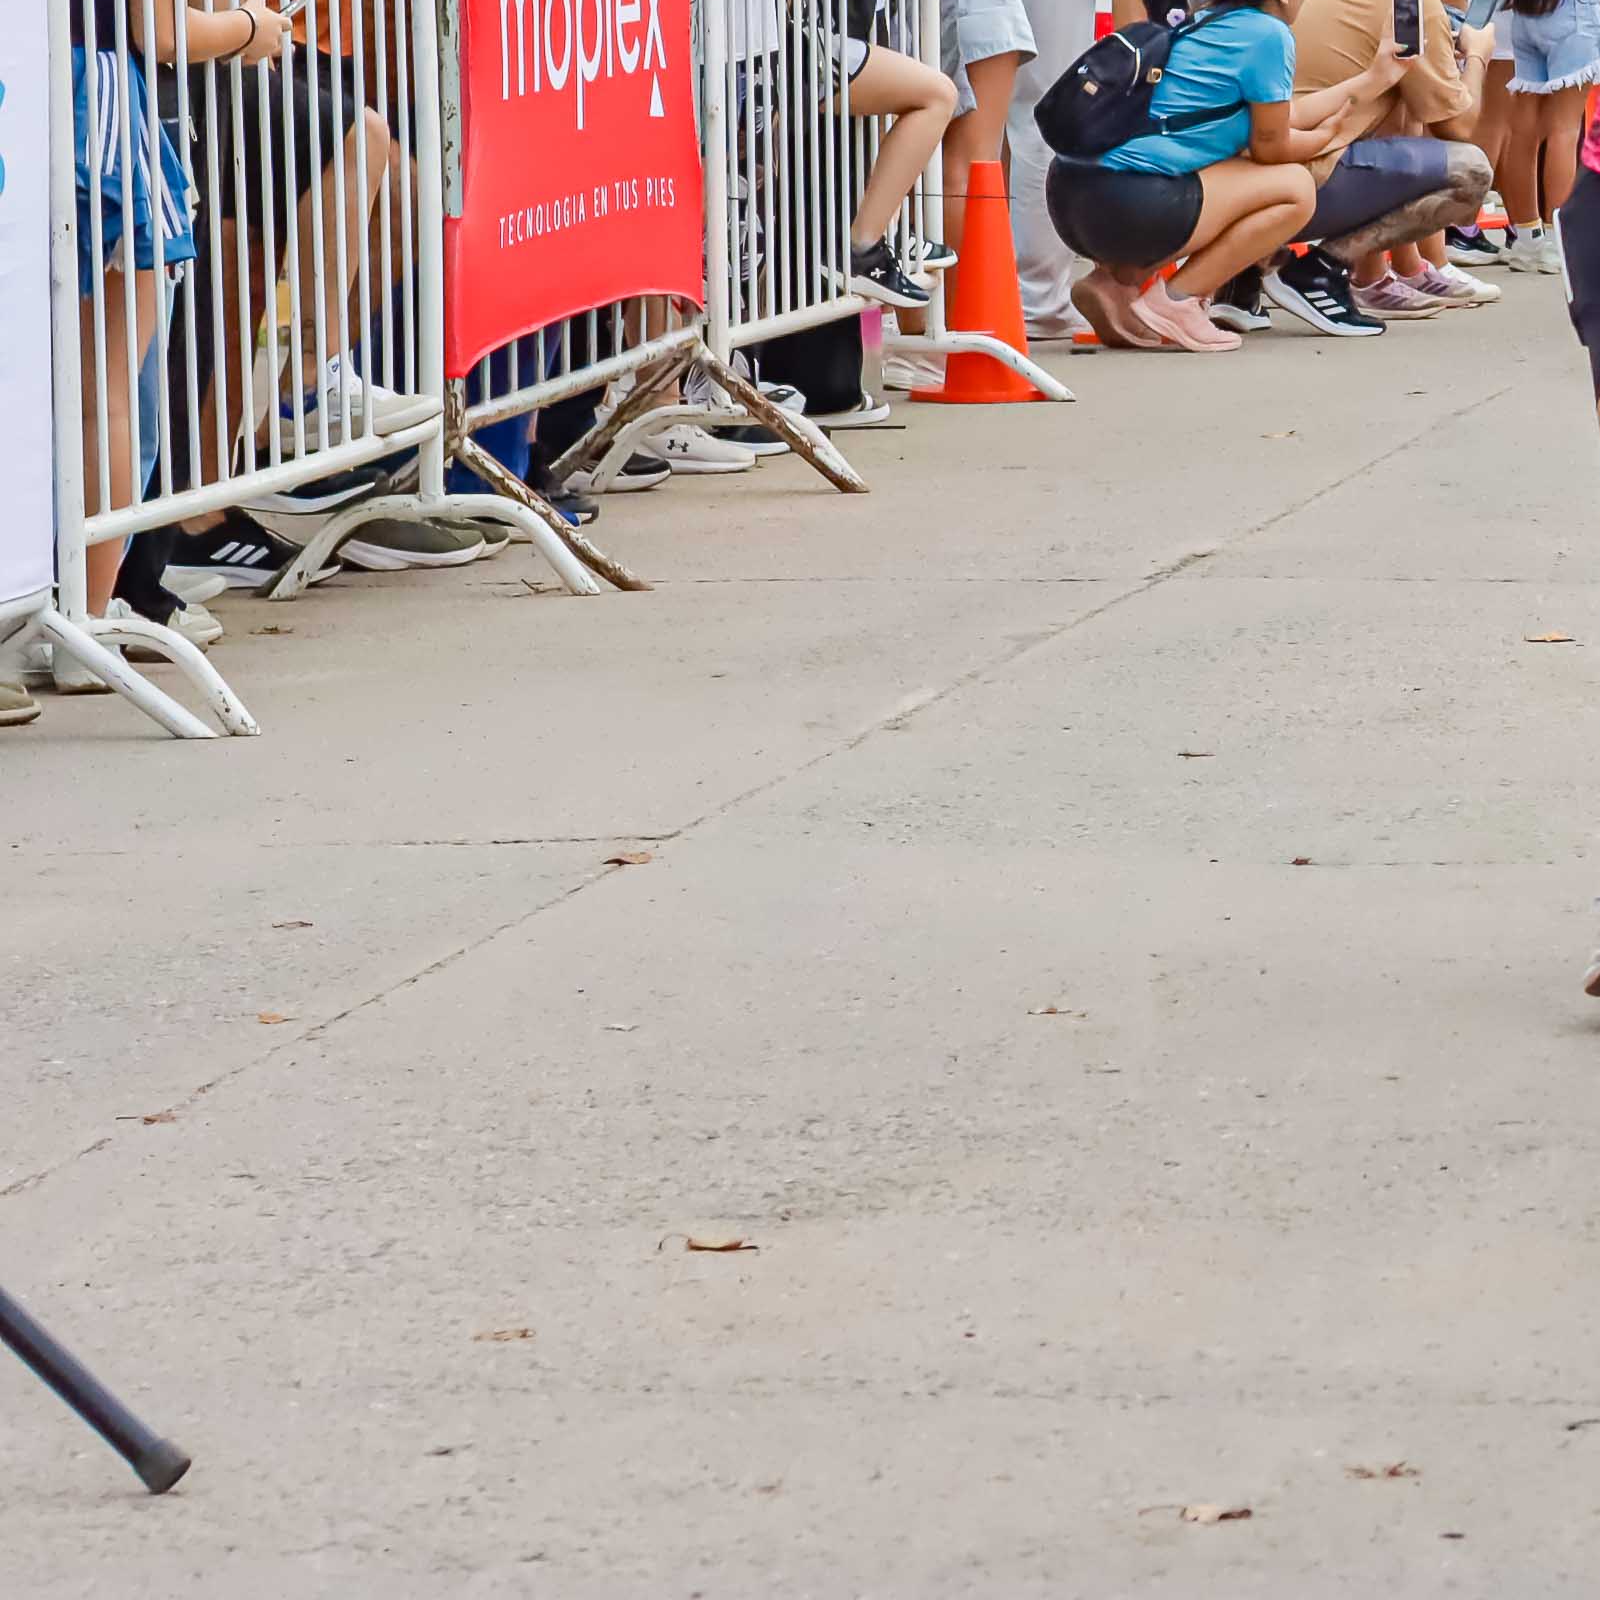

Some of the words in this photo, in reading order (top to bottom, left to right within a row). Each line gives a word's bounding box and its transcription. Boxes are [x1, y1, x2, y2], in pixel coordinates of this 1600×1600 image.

[499, 192, 586, 249] TECNOLOGIA
[593, 186, 608, 218] EN
[614, 178, 638, 210] TUS
[646, 177, 676, 208] PIES
